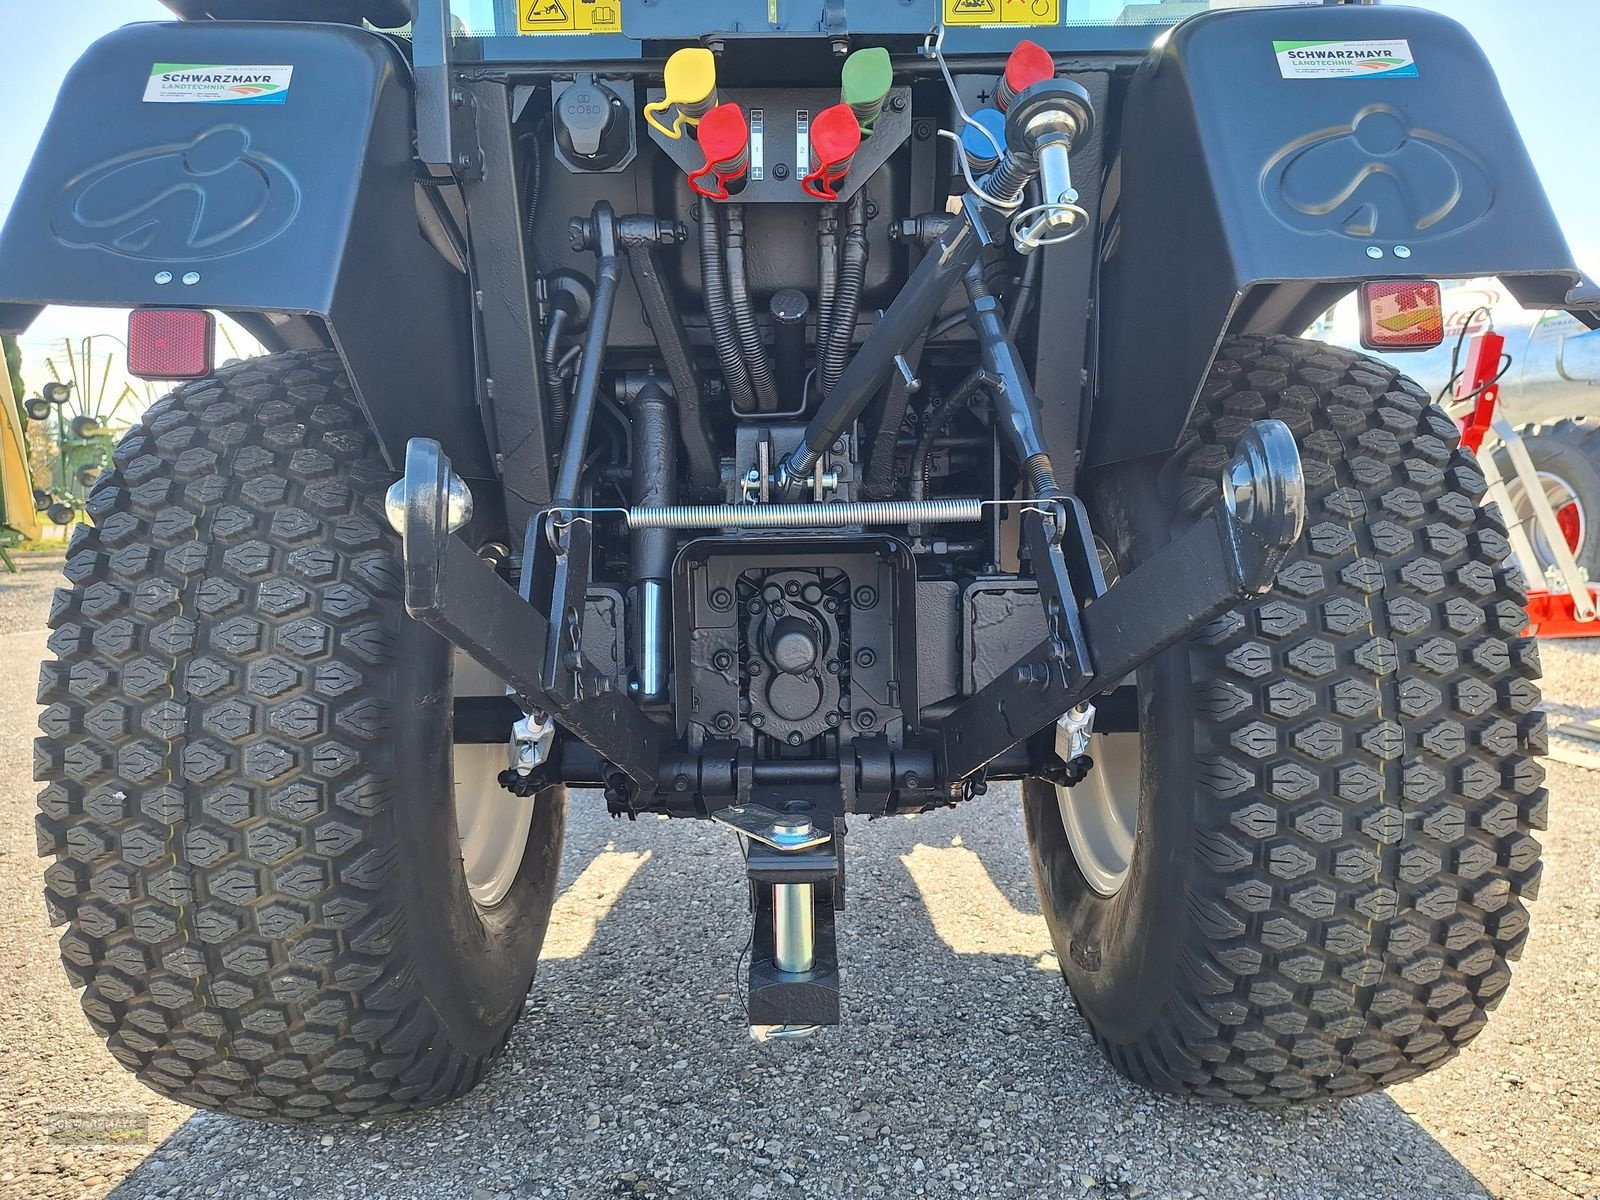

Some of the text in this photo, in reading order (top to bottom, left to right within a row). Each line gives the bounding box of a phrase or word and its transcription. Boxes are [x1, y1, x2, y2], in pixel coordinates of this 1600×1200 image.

[1288, 50, 1393, 59] SCHWARZMAYR
[161, 74, 272, 83] SCHWARZMAYR
[161, 83, 226, 91] LANDTECHNIK
[567, 105, 601, 115] COBO
[799, 146, 805, 154] 2
